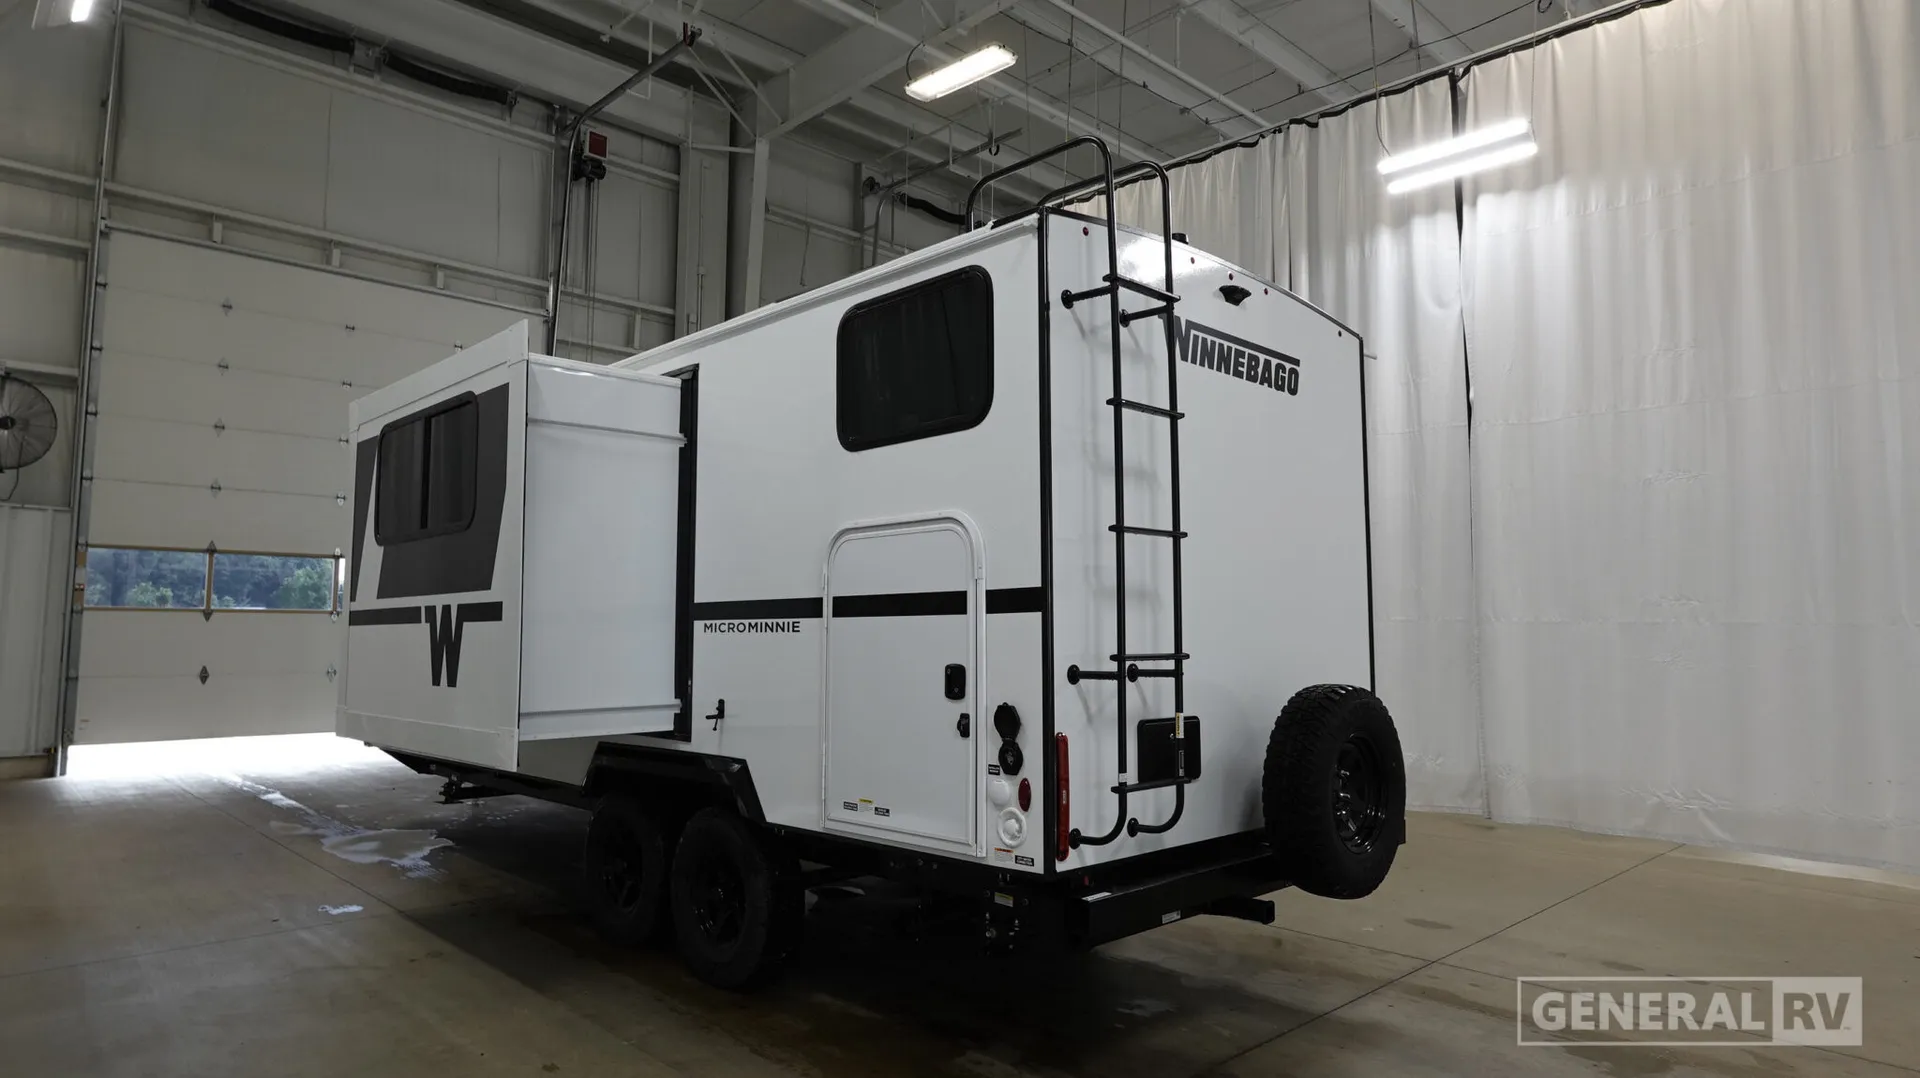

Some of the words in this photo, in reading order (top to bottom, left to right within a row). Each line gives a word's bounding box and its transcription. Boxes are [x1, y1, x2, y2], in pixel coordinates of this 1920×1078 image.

[1158, 312, 1300, 396] WINNEBAGO
[424, 601, 503, 688] W
[703, 621, 801, 633] MICROMINNIE
